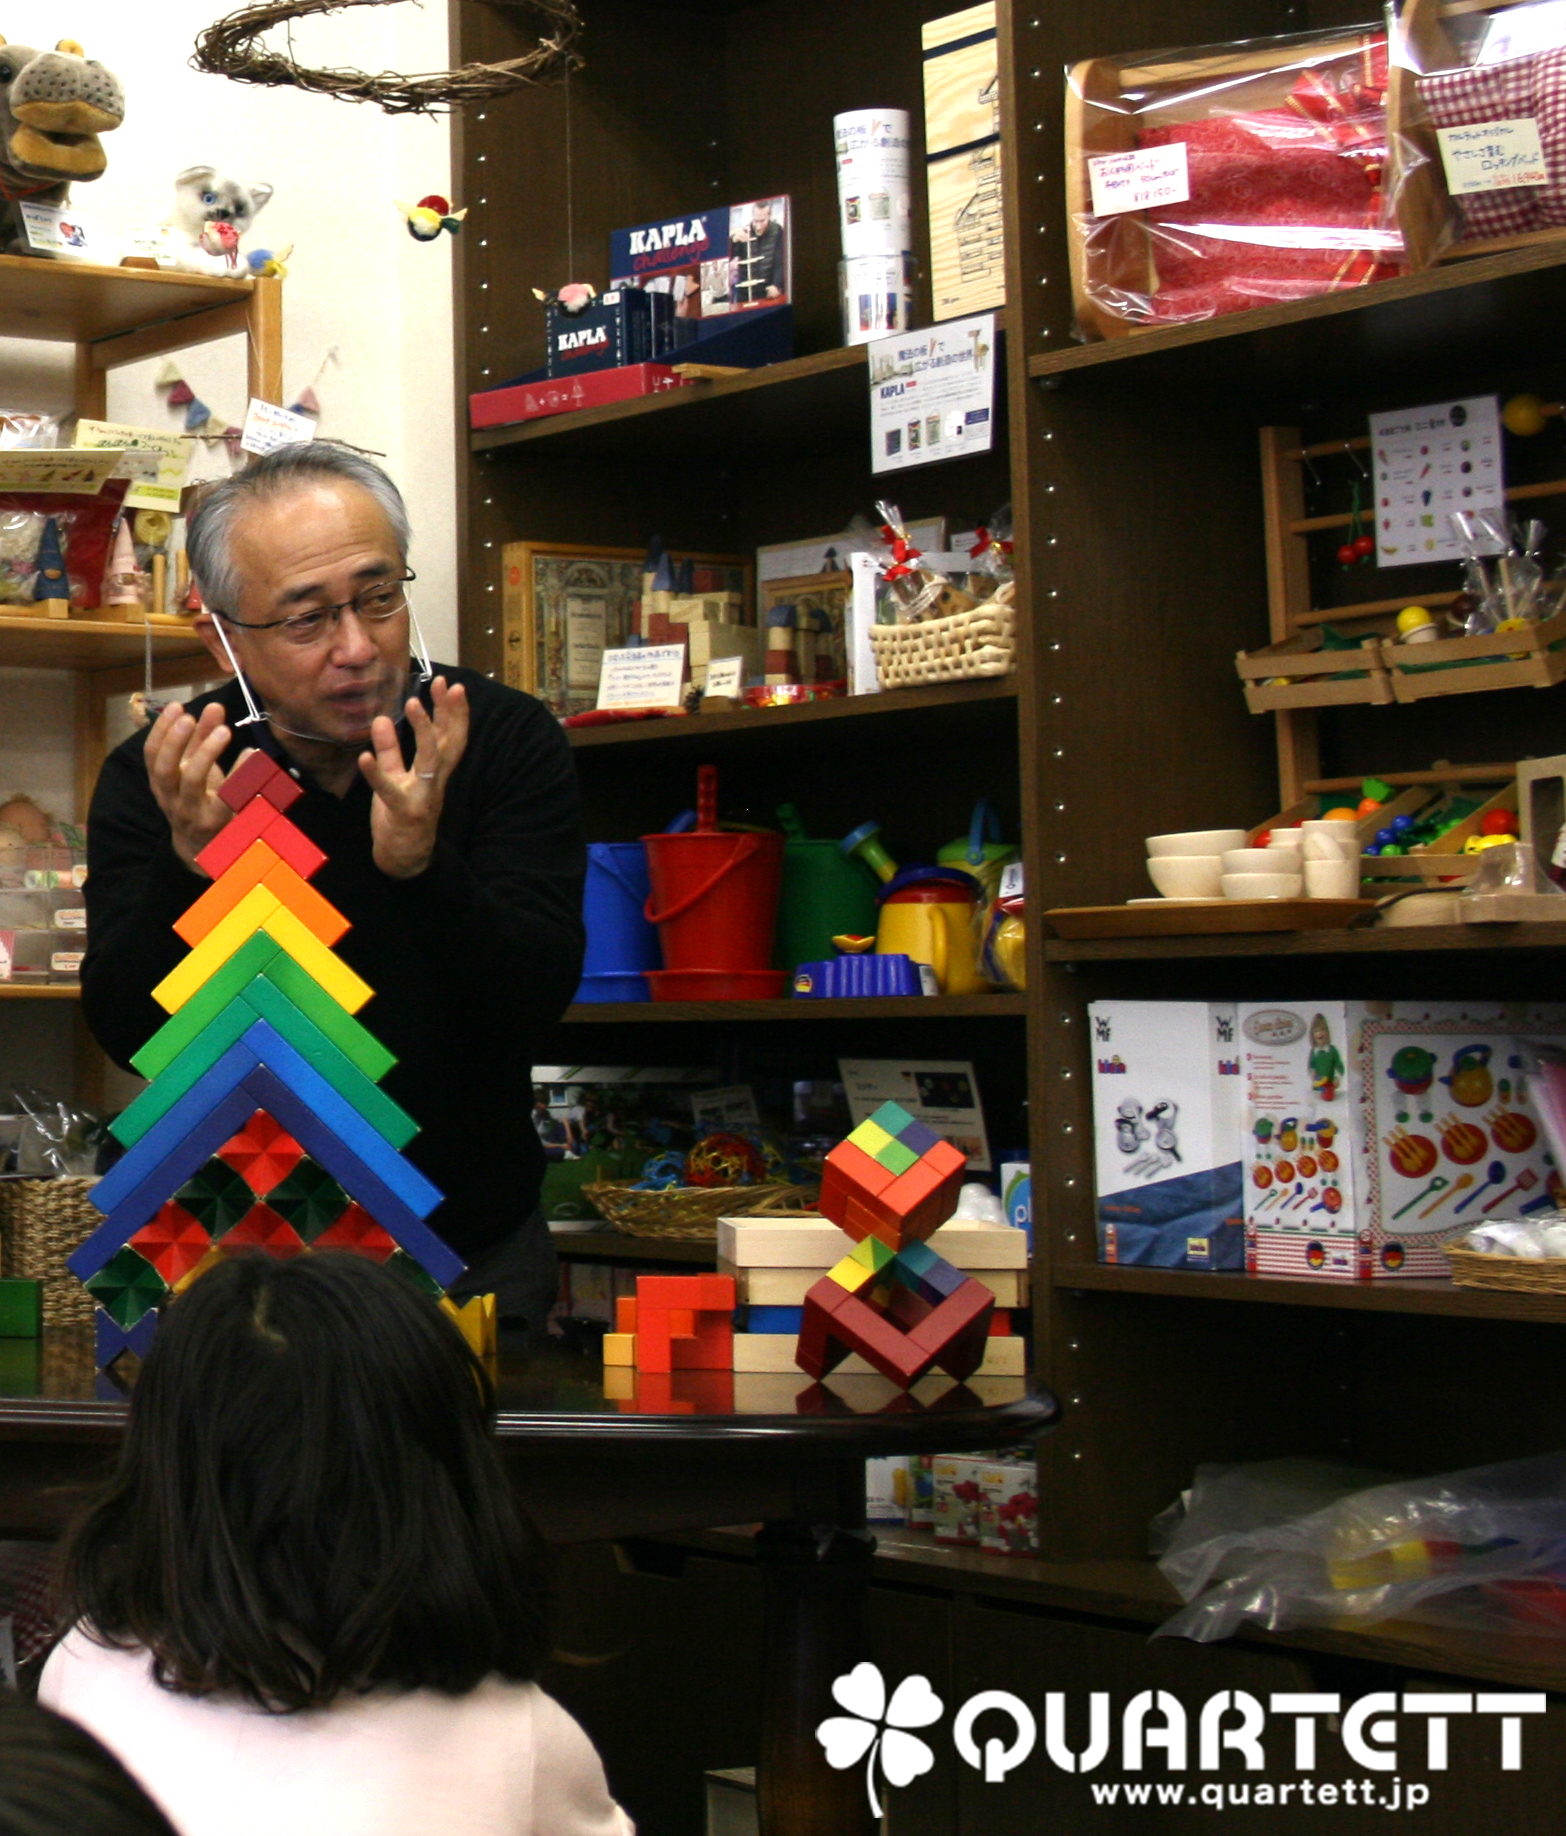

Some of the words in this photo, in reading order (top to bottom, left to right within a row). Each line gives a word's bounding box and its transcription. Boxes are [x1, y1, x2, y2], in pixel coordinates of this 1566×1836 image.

[629, 218, 707, 256] KAPLA
[558, 326, 608, 352] KAPLA
[880, 383, 905, 399] KAPLA
